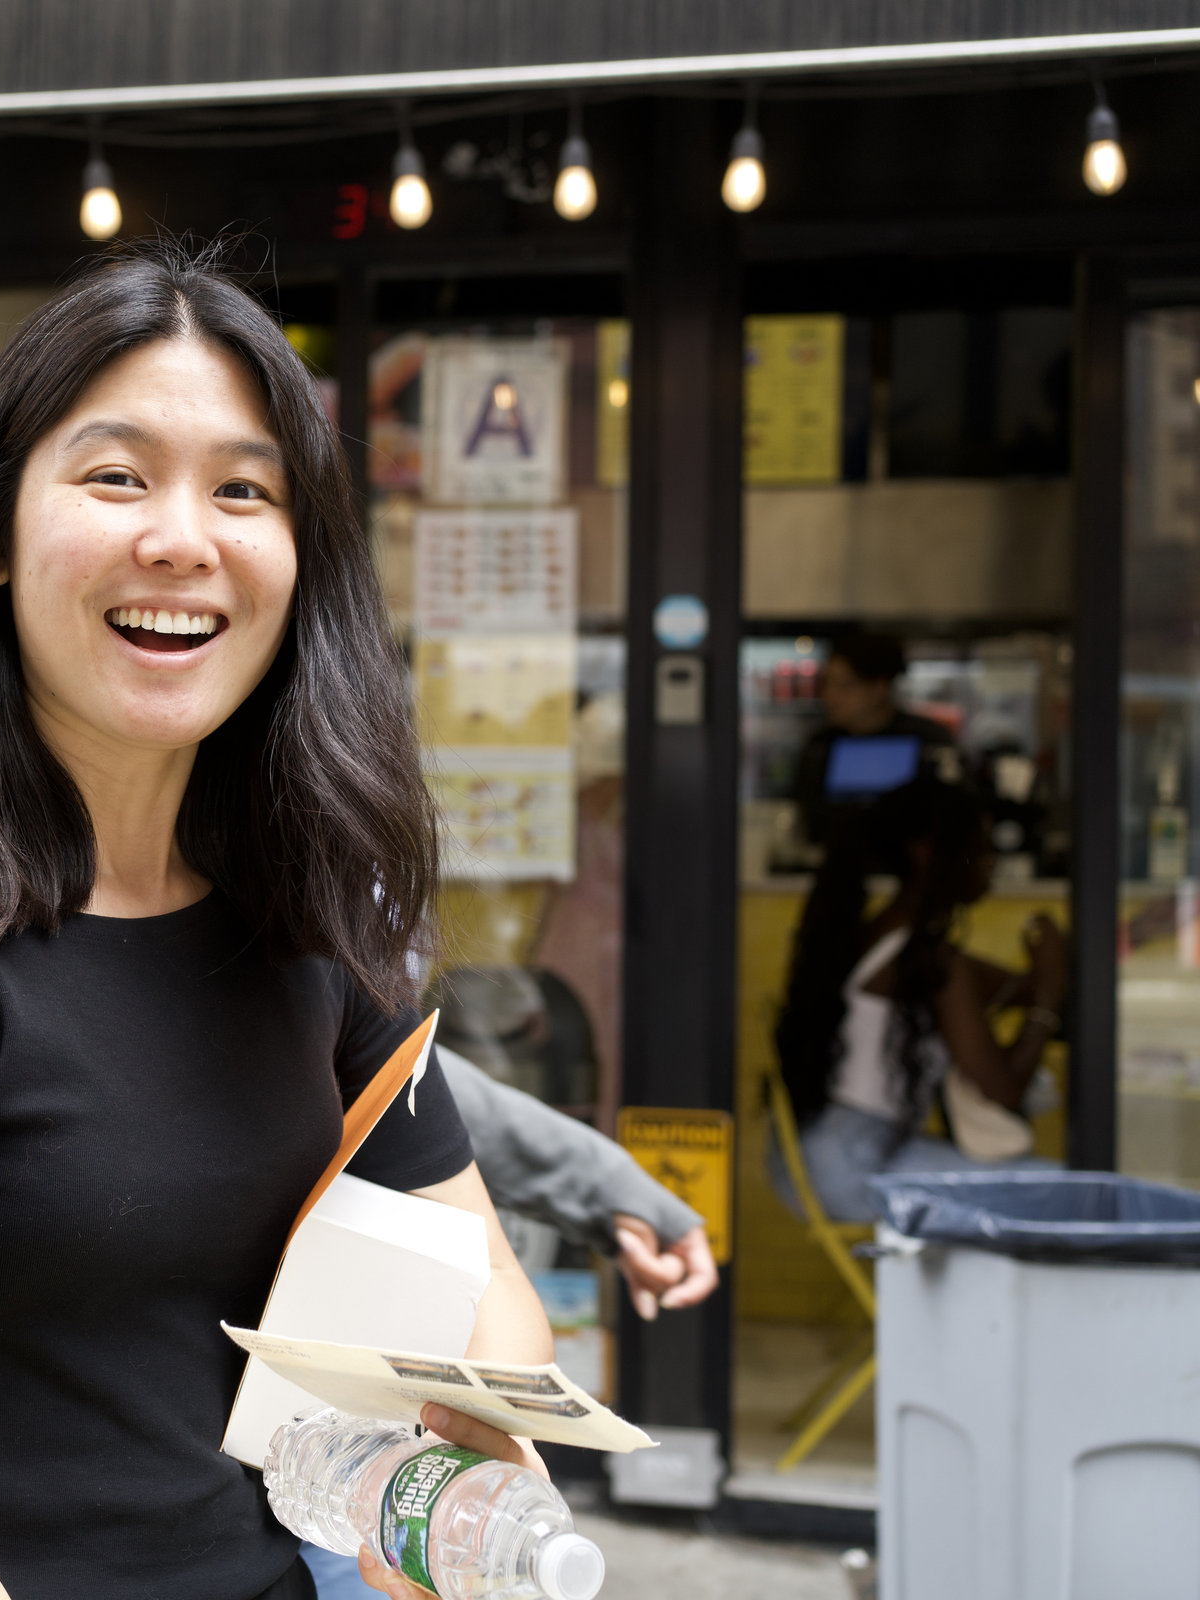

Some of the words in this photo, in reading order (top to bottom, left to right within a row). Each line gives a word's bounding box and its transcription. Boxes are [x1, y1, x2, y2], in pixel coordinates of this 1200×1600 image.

[463, 374, 533, 460] A
[397, 1453, 444, 1517] Spring
[411, 1456, 462, 1518] Poland
